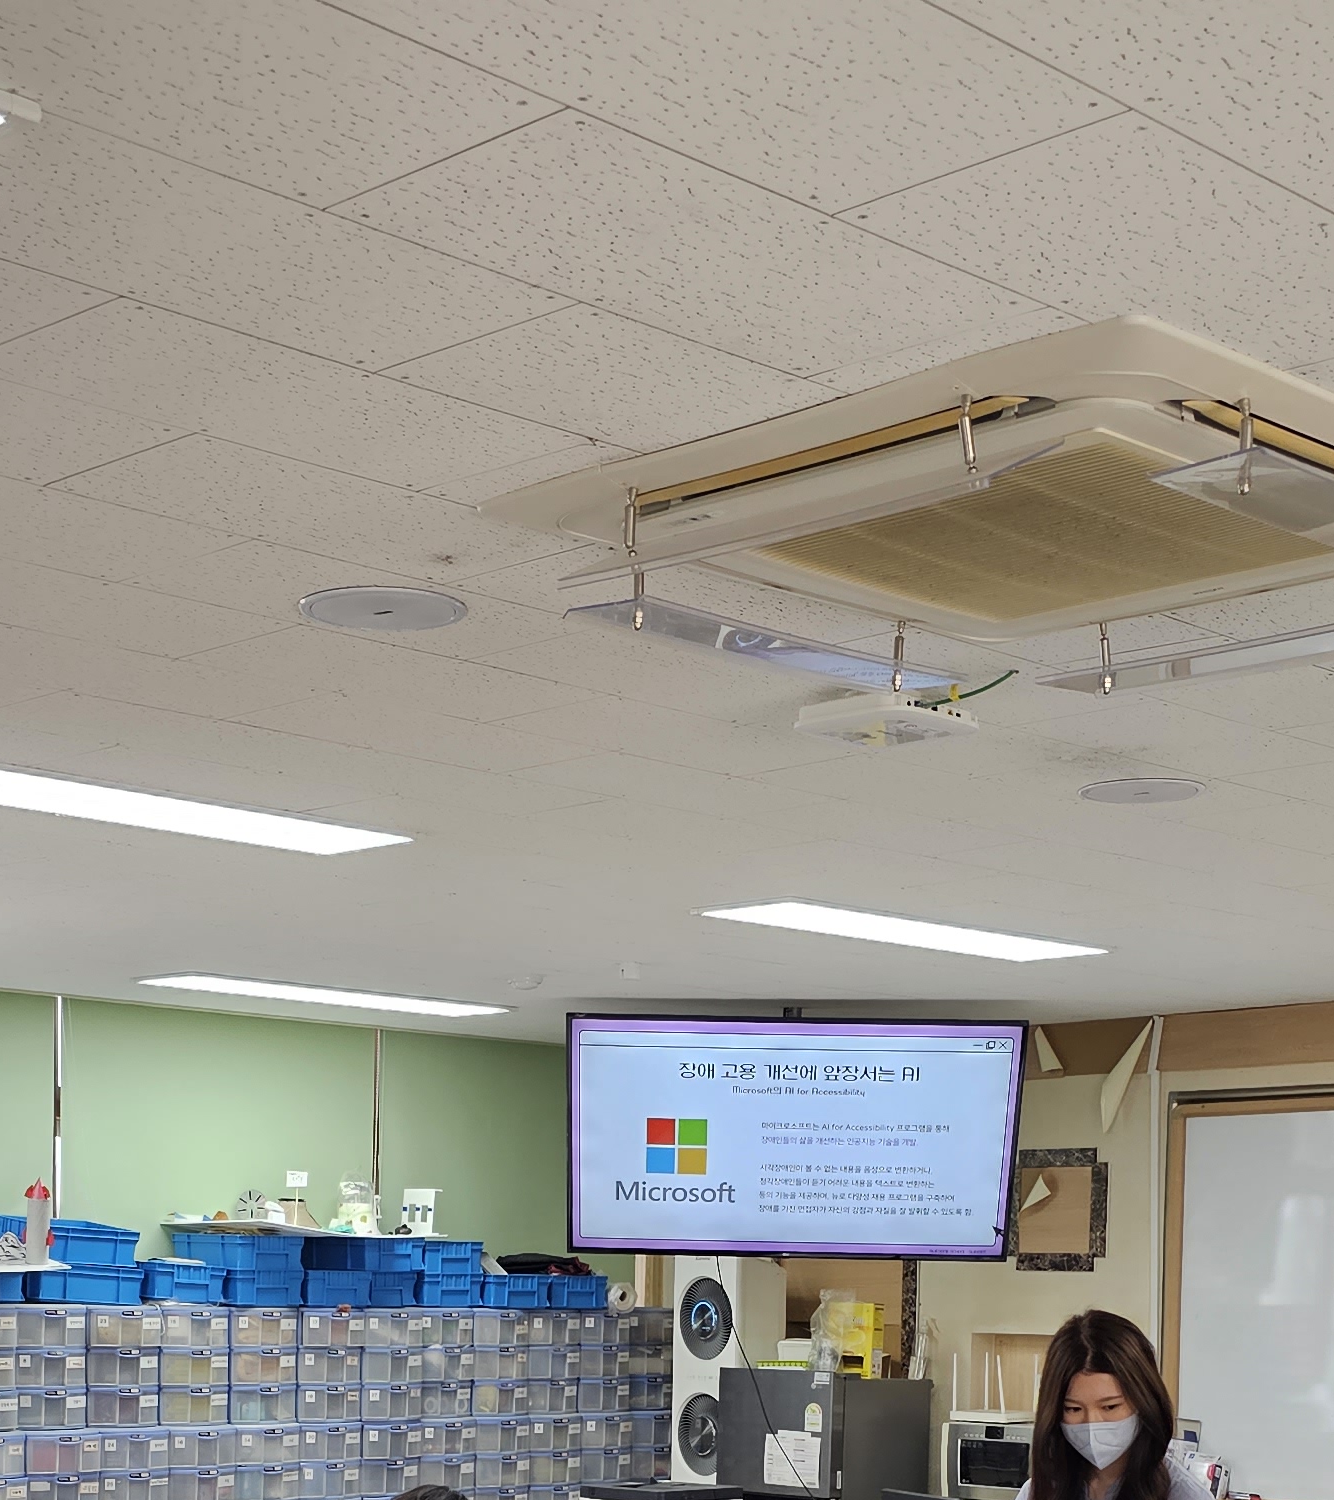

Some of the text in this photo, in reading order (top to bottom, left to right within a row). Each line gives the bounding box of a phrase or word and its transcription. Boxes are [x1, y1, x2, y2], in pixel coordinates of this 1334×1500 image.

[679, 1062, 921, 1083] 장애 고용 개선에 앞장서는 AI
[732, 1085, 782, 1095] Microsoft의
[797, 1087, 809, 1096] for
[811, 1087, 866, 1097] Accessibility
[821, 1123, 830, 1131] AI
[831, 1123, 844, 1131] for
[845, 1123, 895, 1133] Accessibility
[615, 1180, 736, 1204] Microsoft
